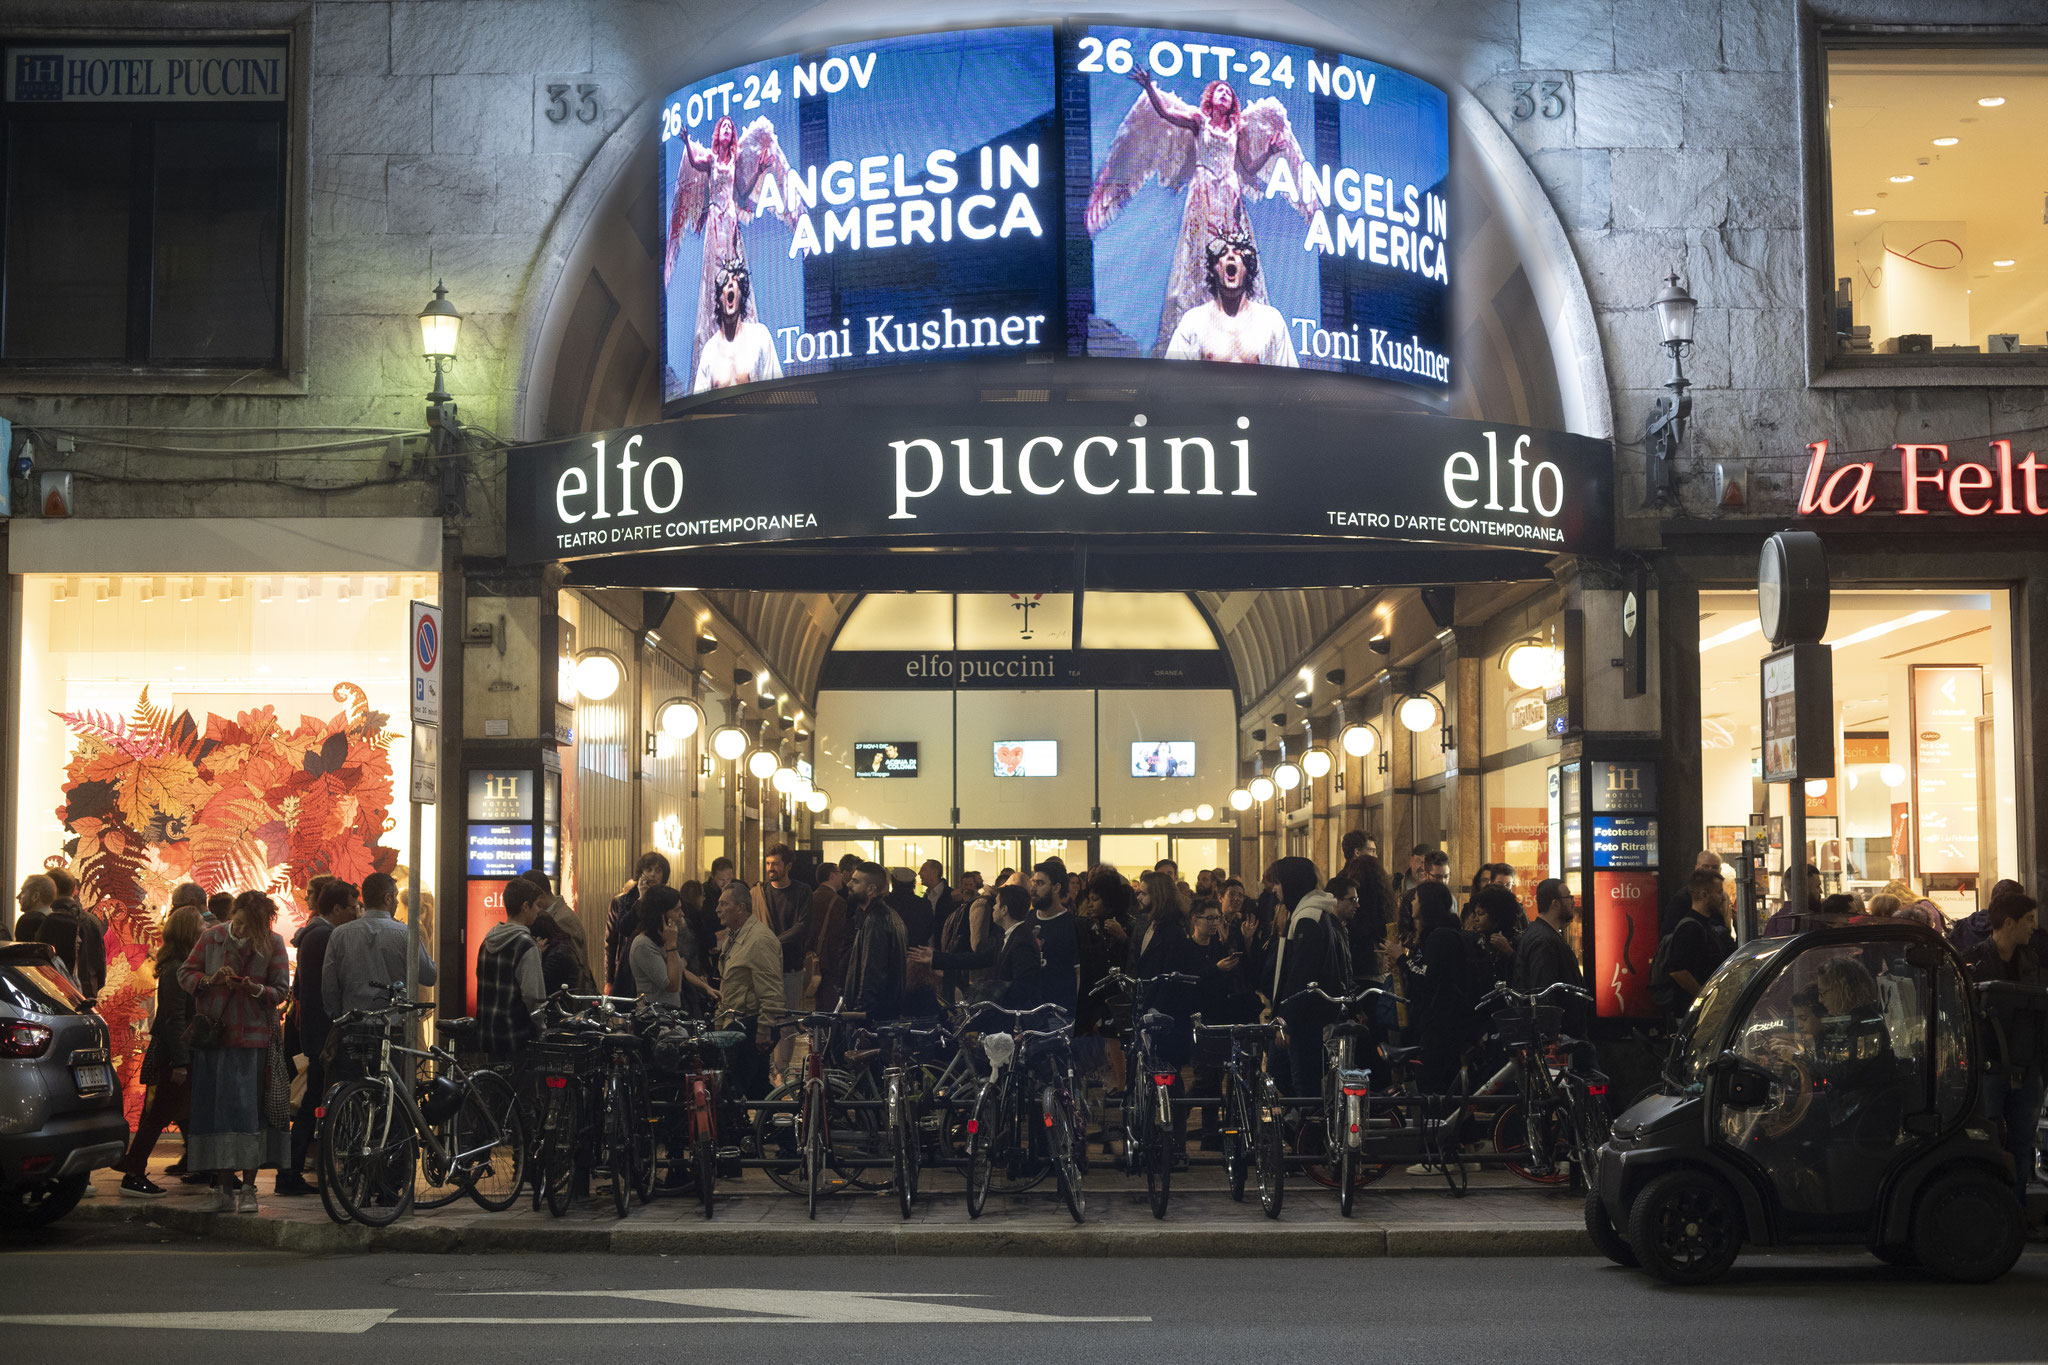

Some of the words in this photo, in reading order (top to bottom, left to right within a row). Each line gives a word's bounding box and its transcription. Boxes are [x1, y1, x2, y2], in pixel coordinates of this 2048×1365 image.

[66, 59, 162, 96] HOTEL
[166, 58, 281, 96] PUCCINI
[1077, 36, 1134, 74] 26
[1148, 40, 1296, 90] OTT-24
[1306, 59, 1376, 106] NOV
[545, 83, 601, 124] 33
[661, 101, 682, 143] 26
[686, 69, 782, 129] OTT-24
[793, 52, 878, 100] NOV
[1511, 81, 1566, 120] 33
[755, 148, 960, 219] ANGELS
[980, 142, 1040, 191] IN
[1265, 157, 1421, 229] ANGELS
[1426, 191, 1448, 241] IN
[788, 192, 1044, 260] AMERICA
[1303, 209, 1449, 286] AMERICA
[777, 316, 853, 365] Toni
[866, 308, 1046, 356] Kushner
[1291, 316, 1360, 364] Toni
[1369, 327, 1451, 384] Kushner
[556, 433, 684, 525] elfo
[887, 413, 1259, 521] puccini
[1443, 430, 1564, 518] elfo
[1797, 438, 1876, 516] la
[556, 528, 608, 549] TEATRO
[611, 523, 662, 543] D'ARTE
[665, 512, 818, 538] CONTEMPORANEA
[1326, 510, 1390, 529] TEATRO
[1394, 514, 1447, 532] D'ARTE
[1449, 517, 1565, 543] CONTEMPORANEA
[905, 653, 954, 678] elfo
[958, 653, 1056, 683] puccini
[484, 774, 519, 799] iH
[1607, 765, 1640, 790] iH
[469, 835, 532, 846] Fototessera
[1593, 827, 1657, 837] Fototessera
[1593, 842, 1619, 852] Foto
[1621, 842, 1657, 851] Ritratti
[469, 850, 495, 860] Foto
[496, 849, 532, 860] Ritratti
[1610, 883, 1641, 899] elfo
